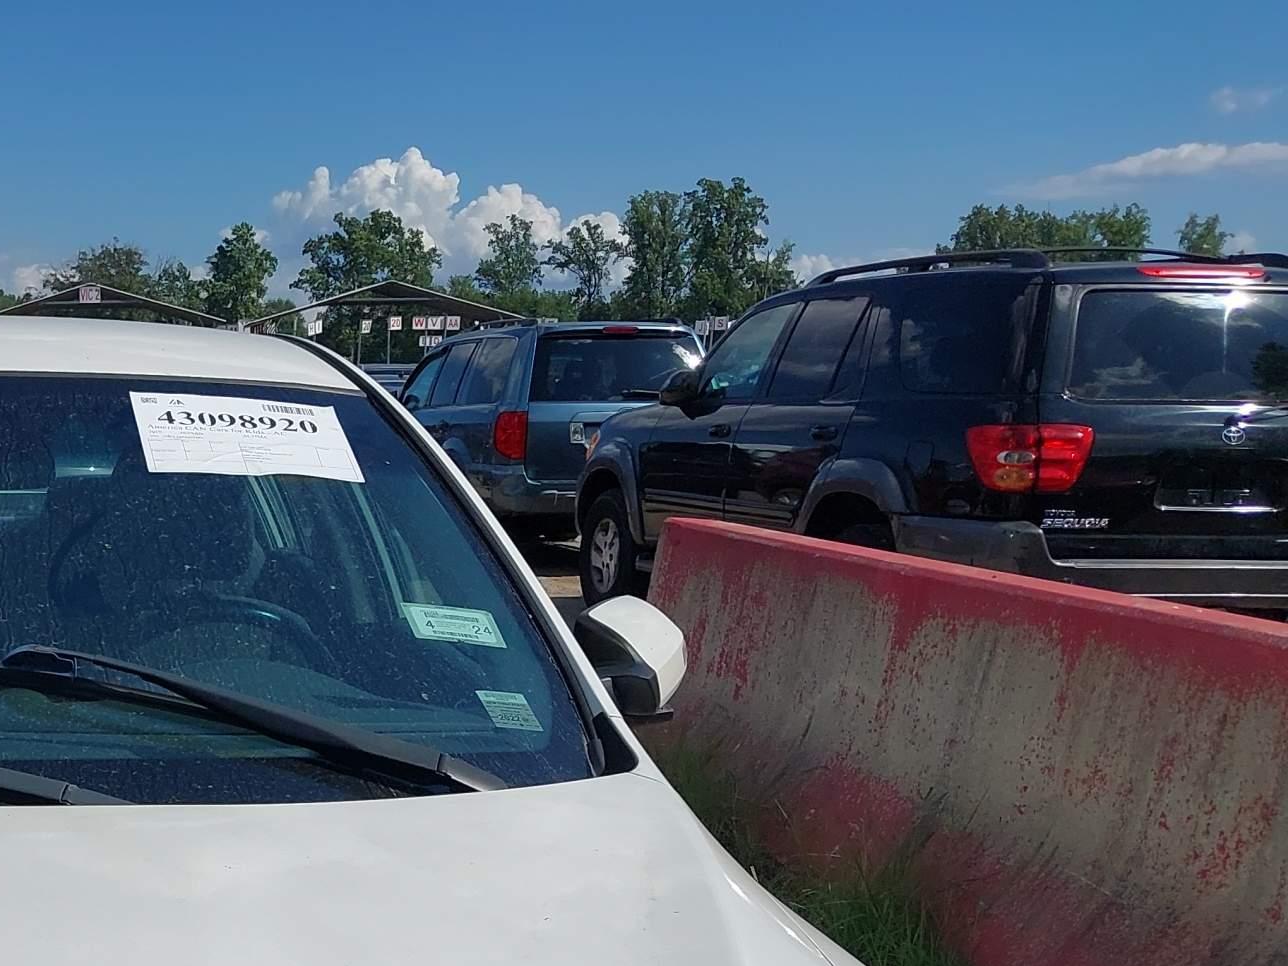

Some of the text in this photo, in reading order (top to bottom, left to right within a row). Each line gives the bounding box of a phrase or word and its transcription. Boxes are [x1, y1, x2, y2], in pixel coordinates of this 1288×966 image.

[80, 288, 94, 300] VIC
[391, 319, 401, 328] 20
[414, 318, 425, 328] W
[430, 318, 439, 328] V
[157, 410, 318, 434] 43098920
[1044, 509, 1076, 517] TOYOTA
[1039, 517, 1111, 529] SEQUOIA
[425, 620, 436, 629] 4
[472, 625, 493, 635] 24
